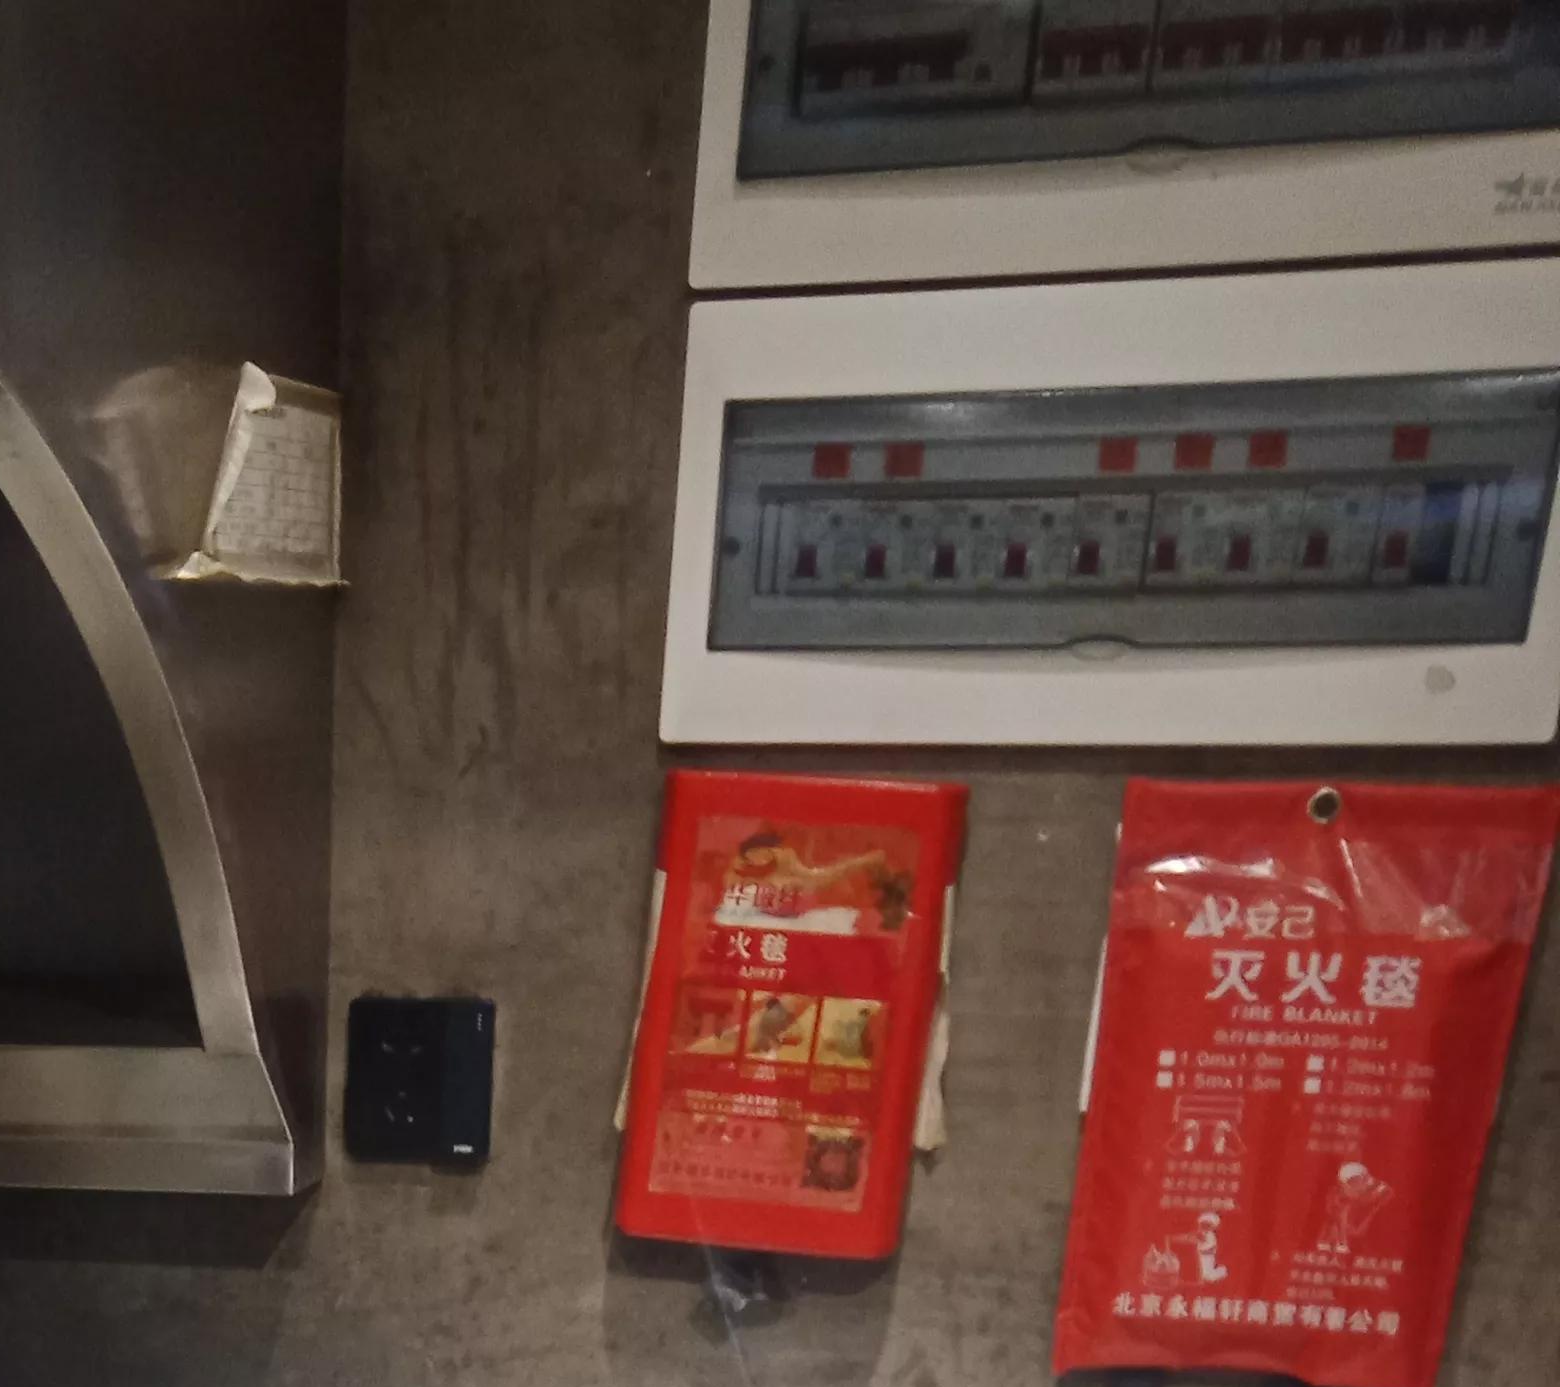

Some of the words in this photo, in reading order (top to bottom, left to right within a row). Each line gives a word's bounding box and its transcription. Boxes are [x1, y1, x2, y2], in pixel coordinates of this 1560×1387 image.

[1204, 949, 1422, 1009] 灭火毯
[1231, 1004, 1273, 1023] FIRE
[1282, 1004, 1377, 1026] BLANKET
